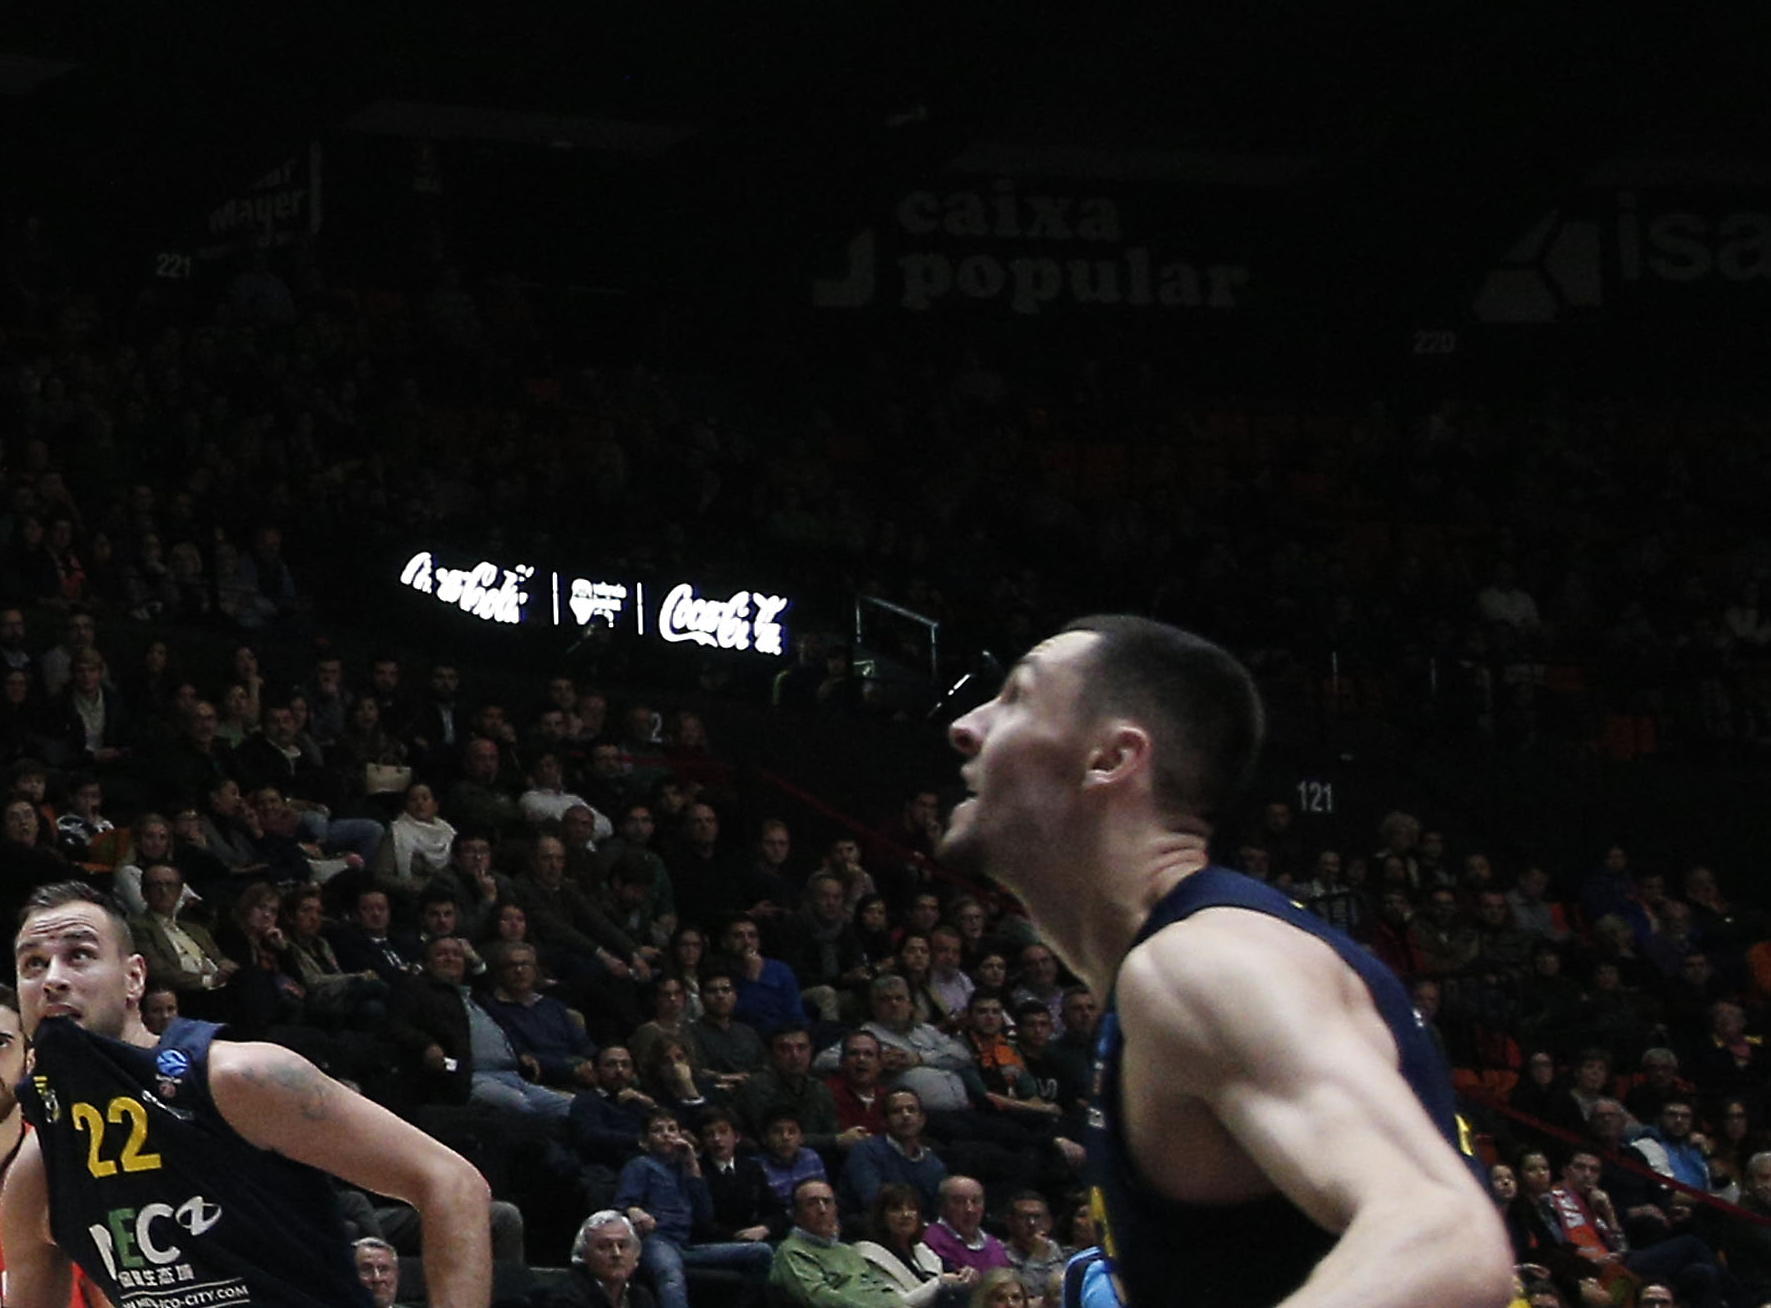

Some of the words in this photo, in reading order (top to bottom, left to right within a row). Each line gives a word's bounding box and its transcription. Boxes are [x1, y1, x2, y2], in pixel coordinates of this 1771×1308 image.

[895, 179, 1122, 242] caixa
[155, 252, 192, 278] 221
[897, 245, 1250, 314] popular
[1296, 779, 1334, 813] 121
[70, 1095, 163, 1179] 22
